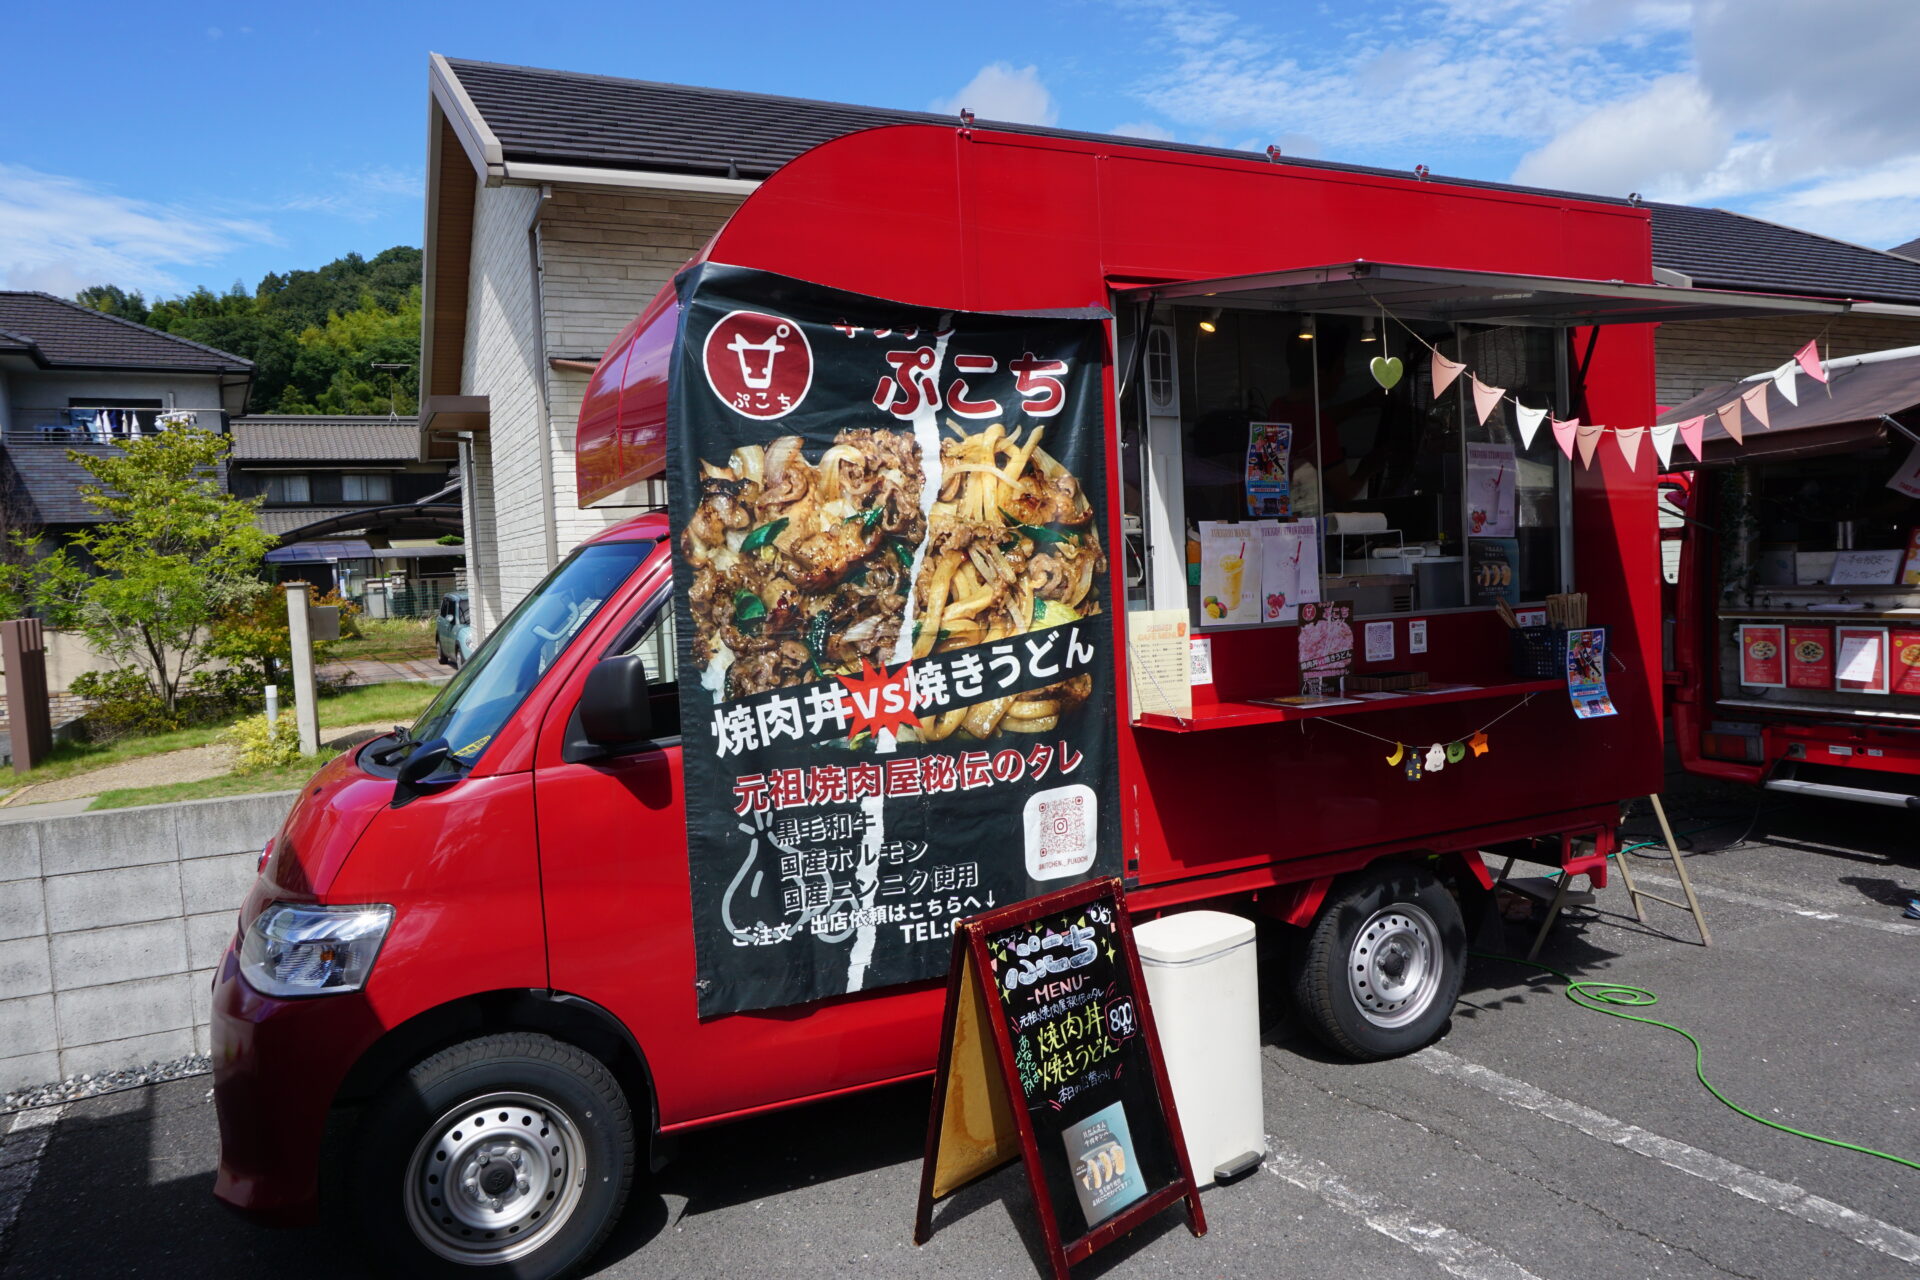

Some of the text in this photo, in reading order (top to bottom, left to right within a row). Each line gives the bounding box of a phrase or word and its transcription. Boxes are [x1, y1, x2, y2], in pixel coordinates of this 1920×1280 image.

[733, 391, 791, 410] ぷこち
[872, 346, 1069, 421] ぷこち
[733, 740, 1084, 816] 元祖焼肉屋秘伝のタレ
[776, 811, 876, 847] 黒毛和牛
[780, 840, 929, 882] 国産ホルモン
[782, 861, 980, 916] 国産ニンニク使用
[732, 895, 982, 947] ご注文・出店依頼はこちらへ
[1005, 924, 1098, 990] ぷこち
[1037, 1001, 1105, 1061] 焼肉丼
[1109, 1002, 1132, 1032] 800
[1037, 1035, 1120, 1092] 焼きうどん
